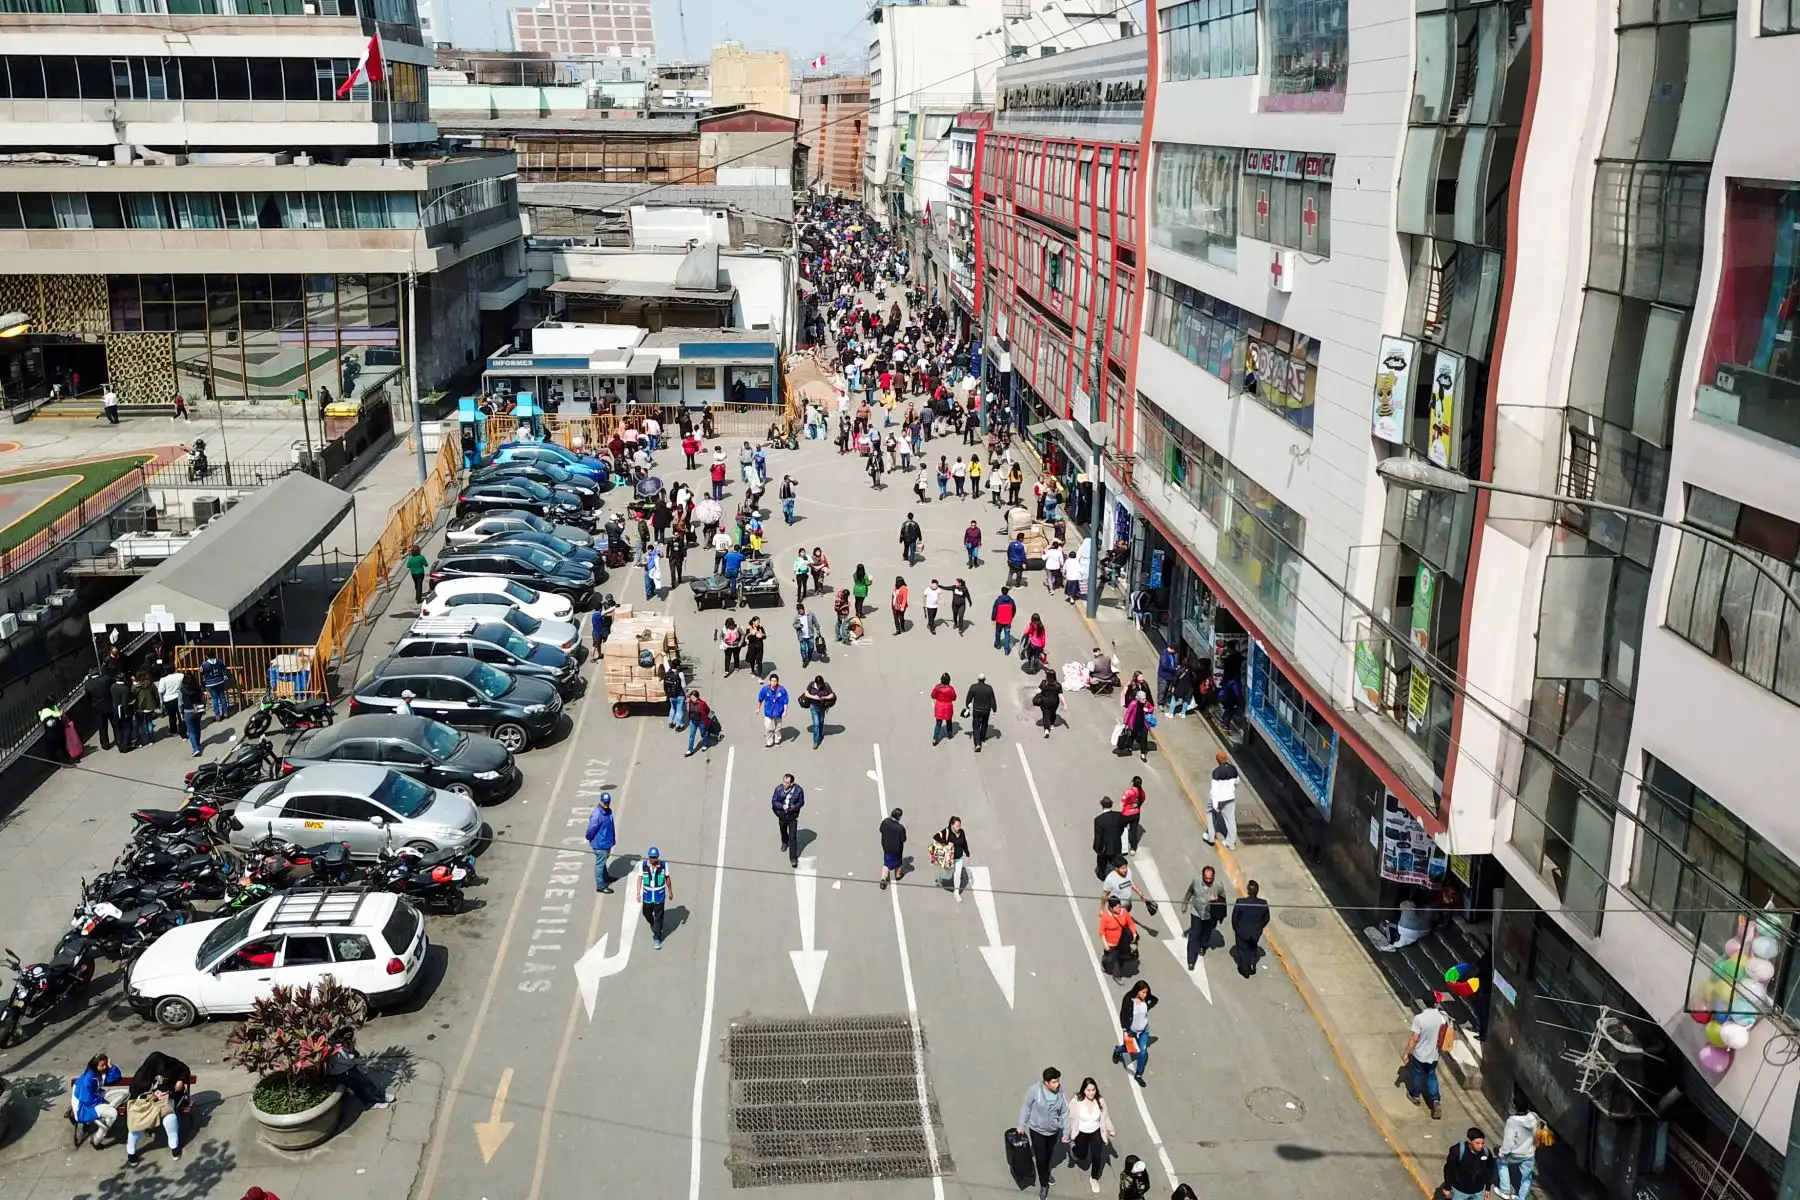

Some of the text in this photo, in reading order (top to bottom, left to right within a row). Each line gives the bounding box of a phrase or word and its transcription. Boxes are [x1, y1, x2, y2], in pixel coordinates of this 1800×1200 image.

[492, 359, 533, 367] INFORMES
[578, 758, 611, 797] ZONA
[518, 836, 588, 993] CARRETILLAS
